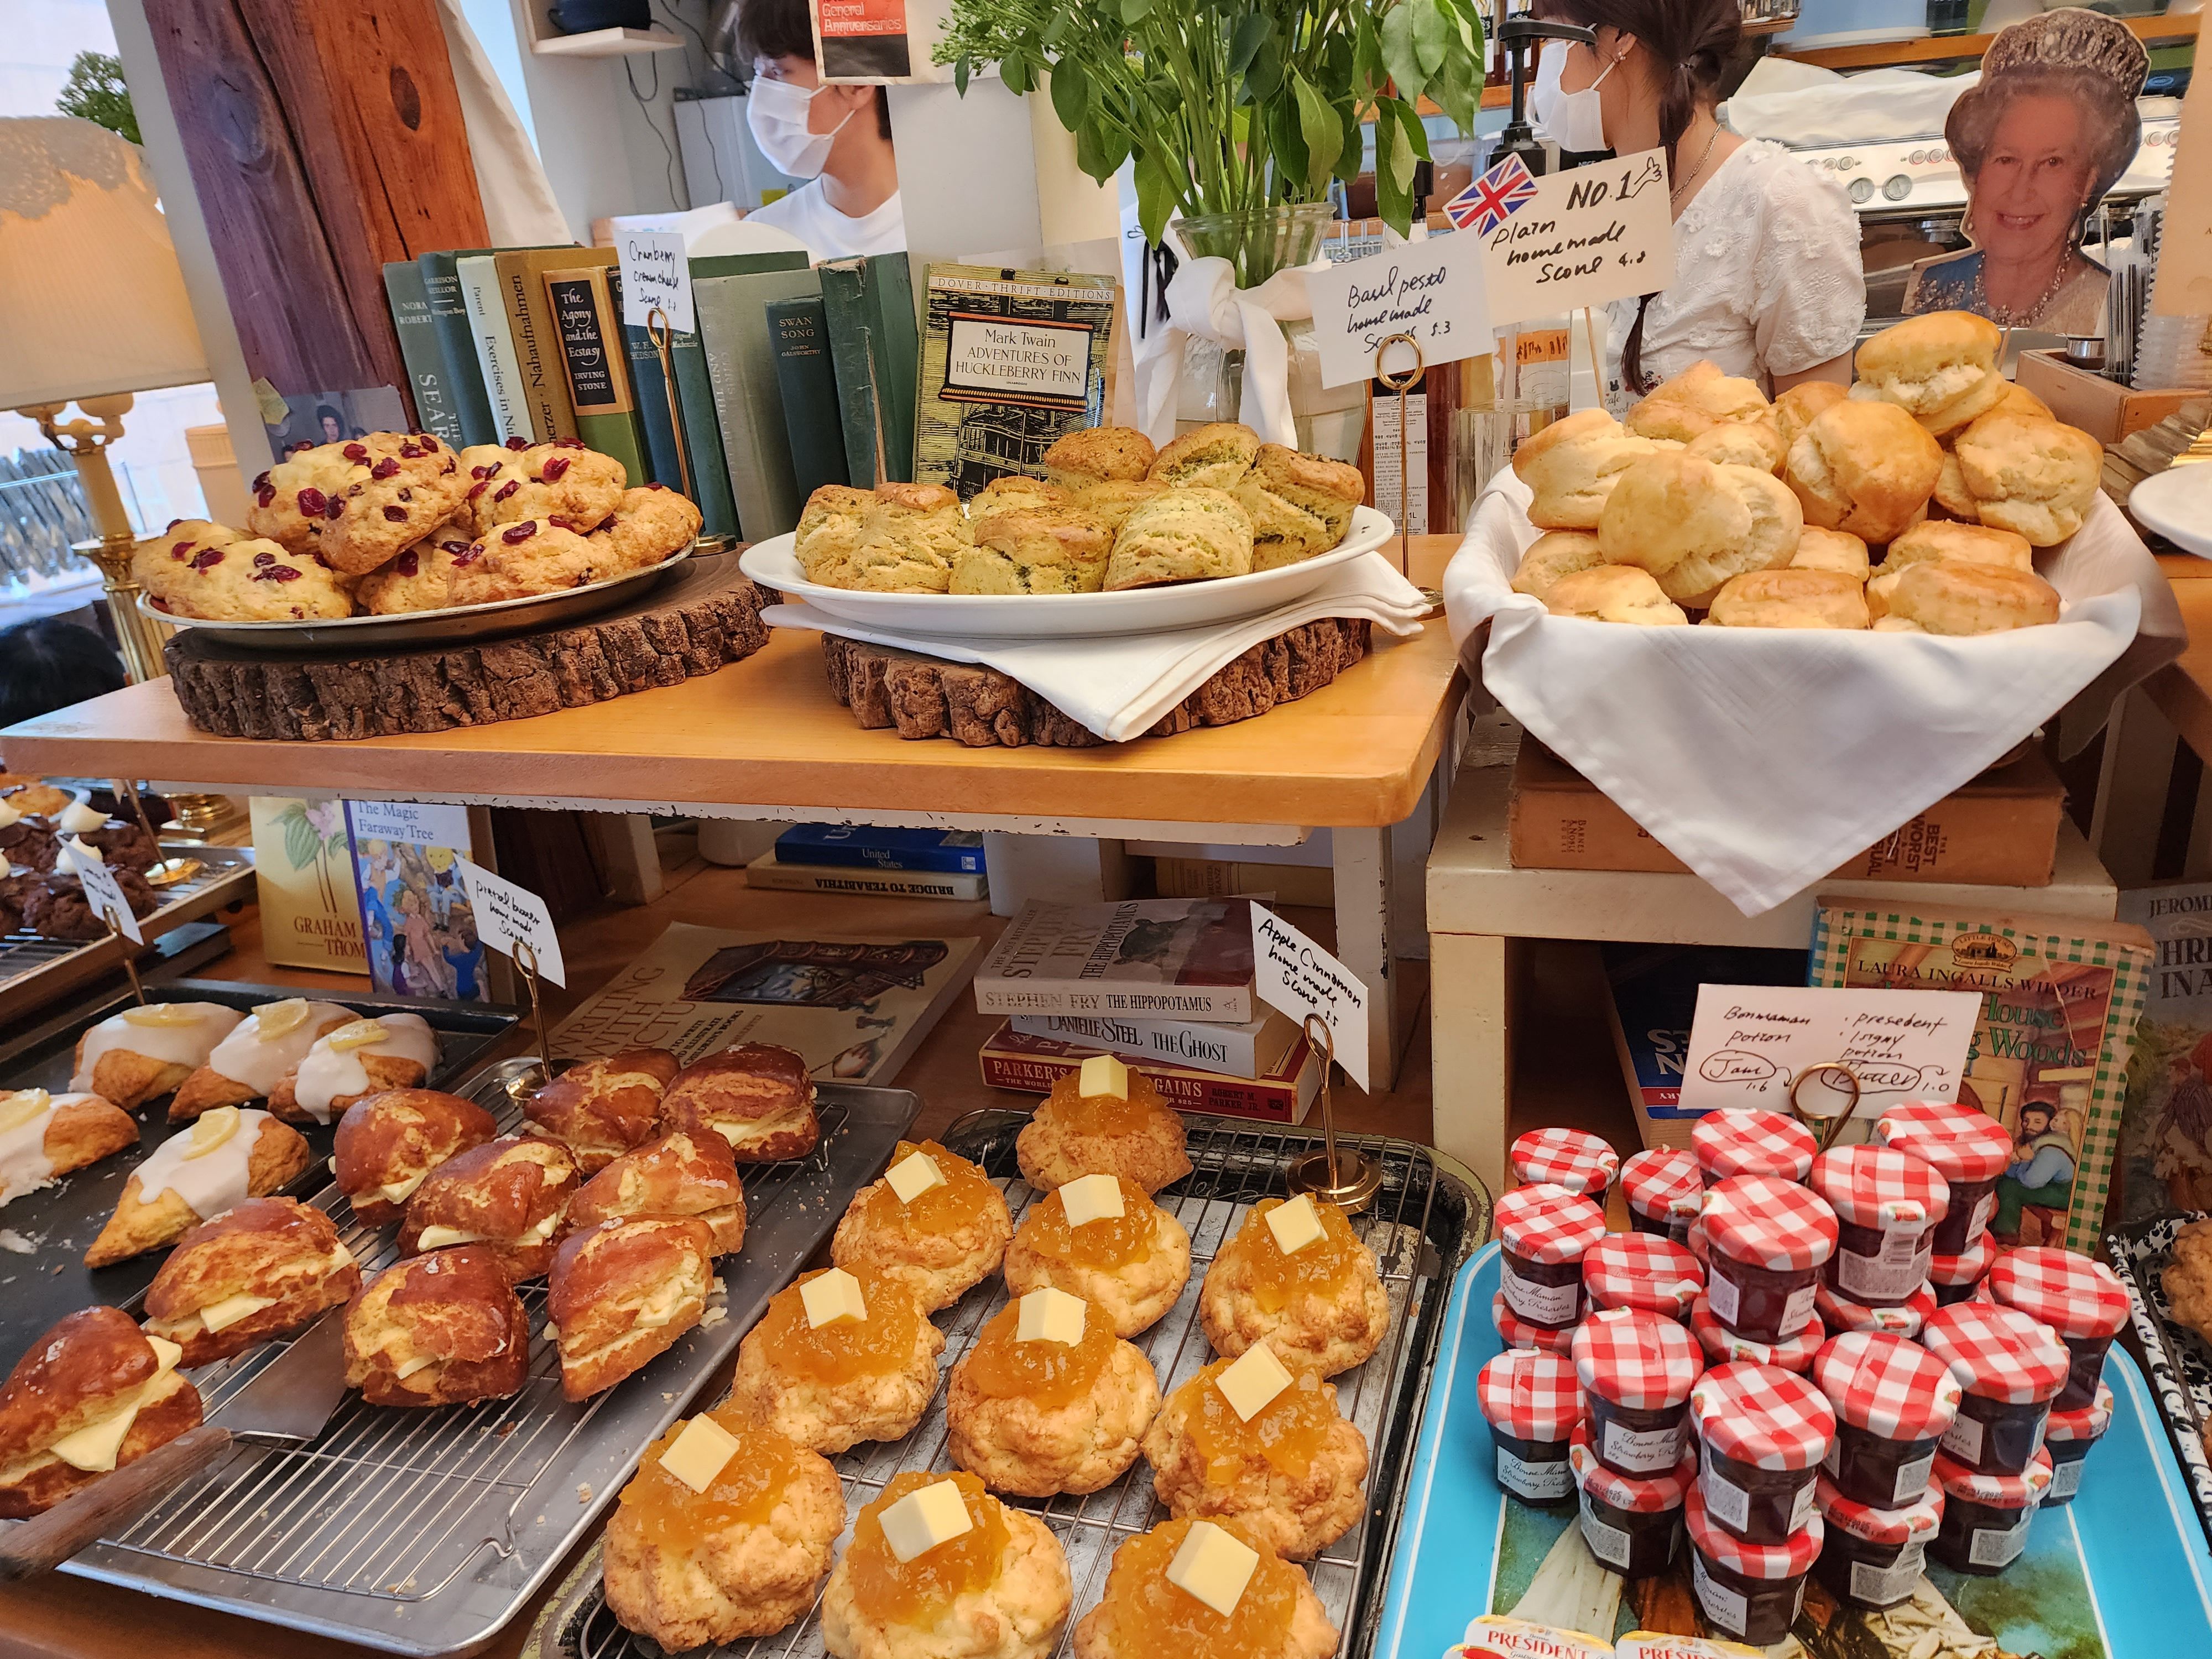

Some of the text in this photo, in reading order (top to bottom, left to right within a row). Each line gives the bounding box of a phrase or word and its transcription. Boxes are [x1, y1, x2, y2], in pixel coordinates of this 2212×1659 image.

[822, 3, 864, 18] General
[824, 18, 901, 34] Anniversaries
[561, 288, 584, 305] The
[938, 278, 1110, 300] DOVER THRIFT EDITIONS
[403, 301, 427, 310] NORA
[473, 286, 486, 316] Parent
[399, 314, 433, 325] ROBERT
[561, 308, 592, 328] Agony
[779, 316, 812, 327] SWAN
[1431, 319, 1451, 337] 5.3
[512, 275, 545, 388] Nahaufnahmen
[781, 330, 815, 339] SONG
[985, 328, 1056, 348] Mark Twain
[568, 346, 601, 366] Ecstasy
[967, 346, 1072, 367] ADVENTURES OF
[484, 336, 508, 411] Exercises in
[574, 371, 606, 380] IRVING
[708, 352, 721, 384] AND
[956, 361, 1081, 384] HUCKLEBERRY FINN
[577, 382, 607, 390] STONE
[418, 374, 450, 439] SEAR
[359, 801, 419, 821] The Magic
[358, 818, 434, 840] Faraway Tree
[1578, 820, 1587, 853] BARNES
[862, 848, 890, 859] United
[1885, 830, 1900, 867] OST
[1906, 815, 1925, 873] WORST
[1923, 824, 1940, 866] BEST
[878, 859, 902, 868] States
[815, 878, 889, 892] TERABITHIA
[891, 883, 906, 893] TO
[909, 884, 953, 895] BRIDGE
[294, 916, 356, 938] GRAHAM
[324, 938, 366, 958] THOM
[1079, 903, 1139, 979] THE HIPPOPOTAMUS
[1258, 918, 1361, 1009] Apple Cinnamon
[1268, 945, 1338, 1008] home made
[1859, 960, 1921, 979] LAURA
[1929, 963, 2013, 989] INGALLS
[2020, 979, 2097, 1000] WILDER
[2161, 969, 2194, 999] IN
[1282, 971, 1317, 1009] Scone
[549, 967, 665, 1055] WRITING
[985, 992, 1212, 1012] STEPHEN FRY THE HIPPOPOTAMUS
[576, 1000, 664, 1057] WITH
[719, 1010, 744, 1030] BOOKS
[1047, 1015, 1228, 1063] DANIELLE STEEL THE GHOST
[1989, 1026, 2086, 1067] Woods
[993, 1061, 1203, 1097] PARKER'S GAINS
[1746, 1082, 1767, 1093] 1.6
[1212, 1088, 1257, 1101] ROBERT M.
[1621, 1432, 1656, 1447] Bonne
[1610, 1441, 1655, 1462] Strawberry
[1503, 1465, 1541, 1490] Strawberry
[1511, 1458, 1540, 1476] Bonne
